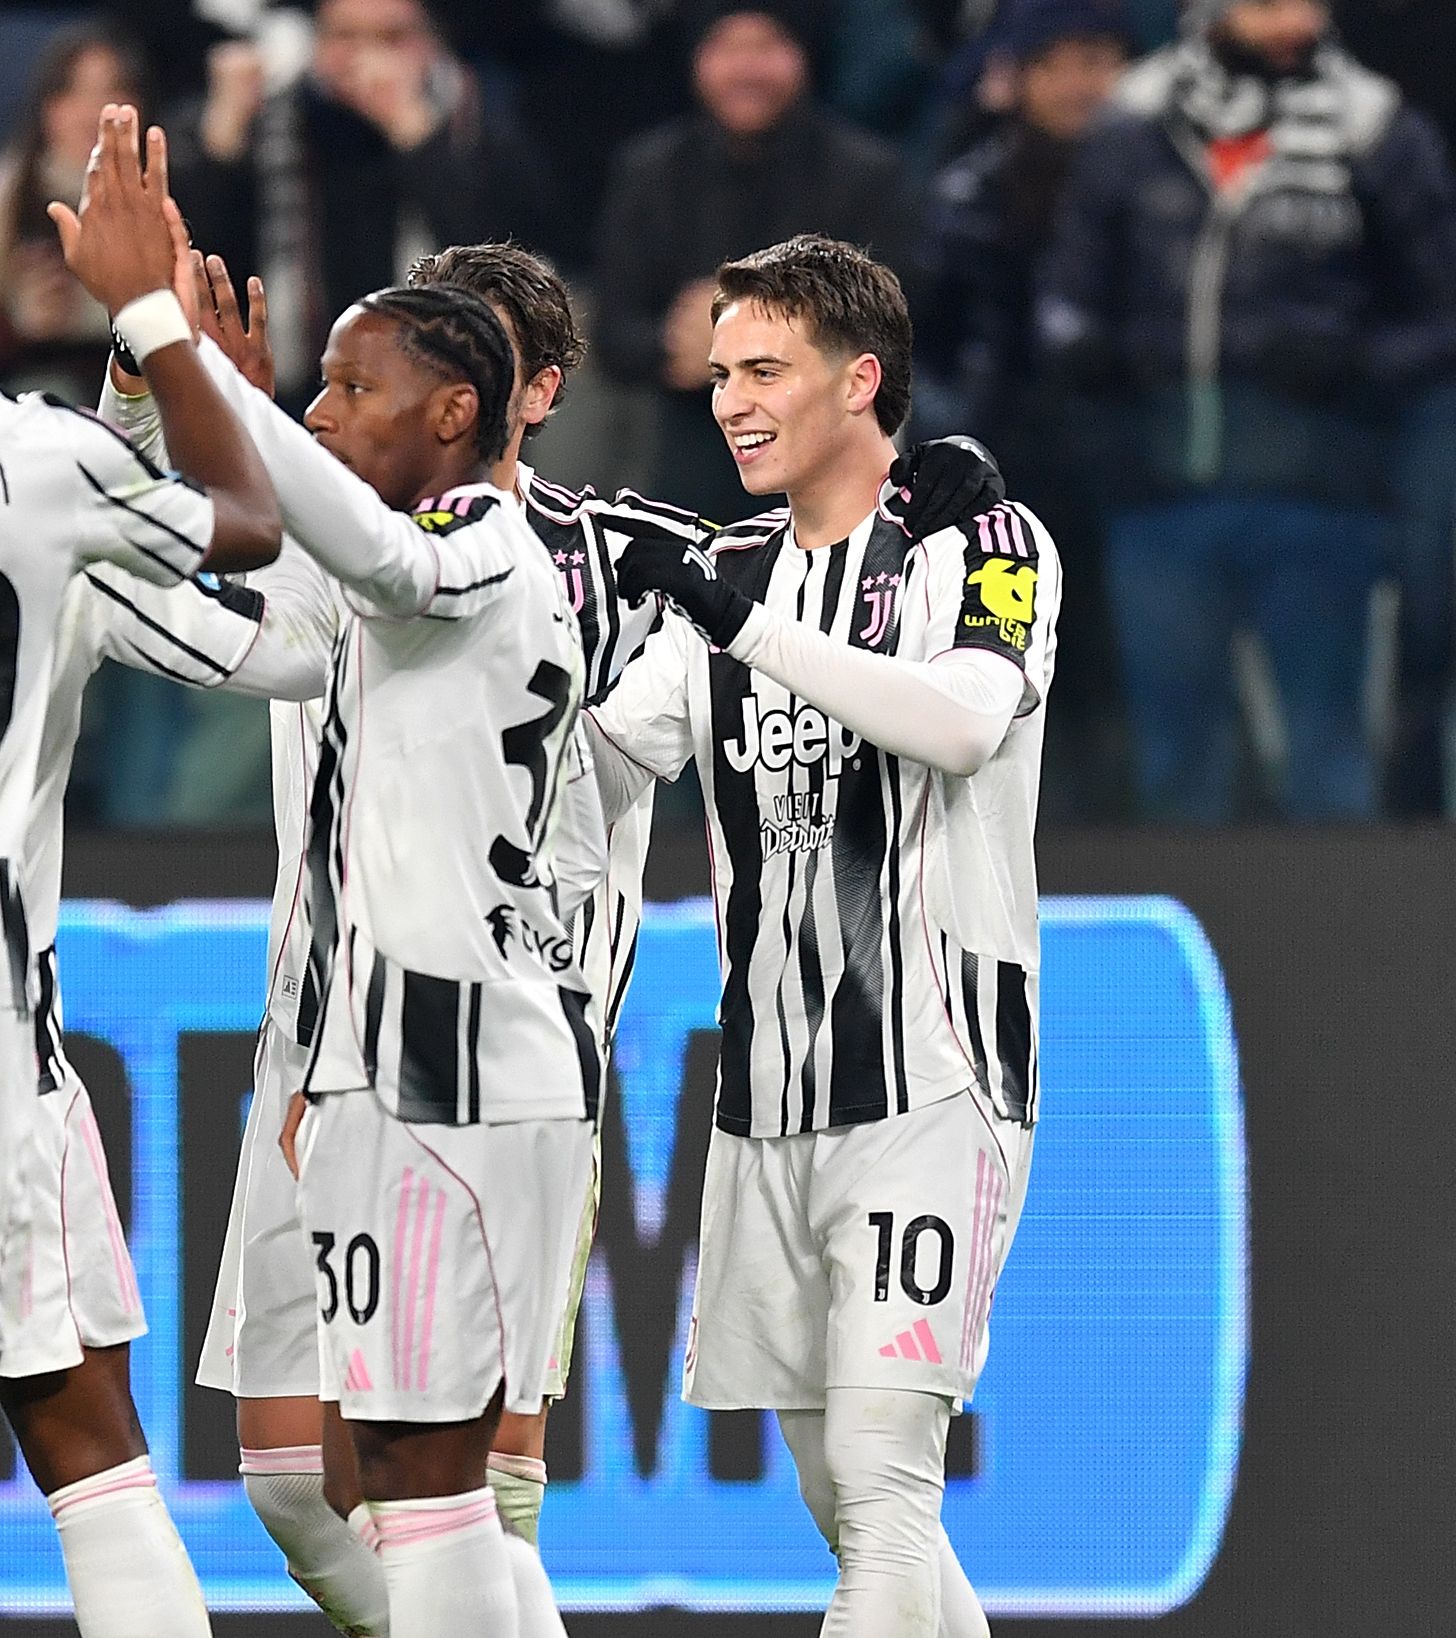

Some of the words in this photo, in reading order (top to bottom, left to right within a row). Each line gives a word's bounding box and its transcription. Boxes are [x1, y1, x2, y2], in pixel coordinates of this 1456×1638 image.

[723, 695, 863, 777] Jeep
[760, 815, 835, 862] Detroit
[773, 793, 820, 822] VISIT
[311, 1231, 380, 1325] 30
[868, 1211, 955, 1306] 10
